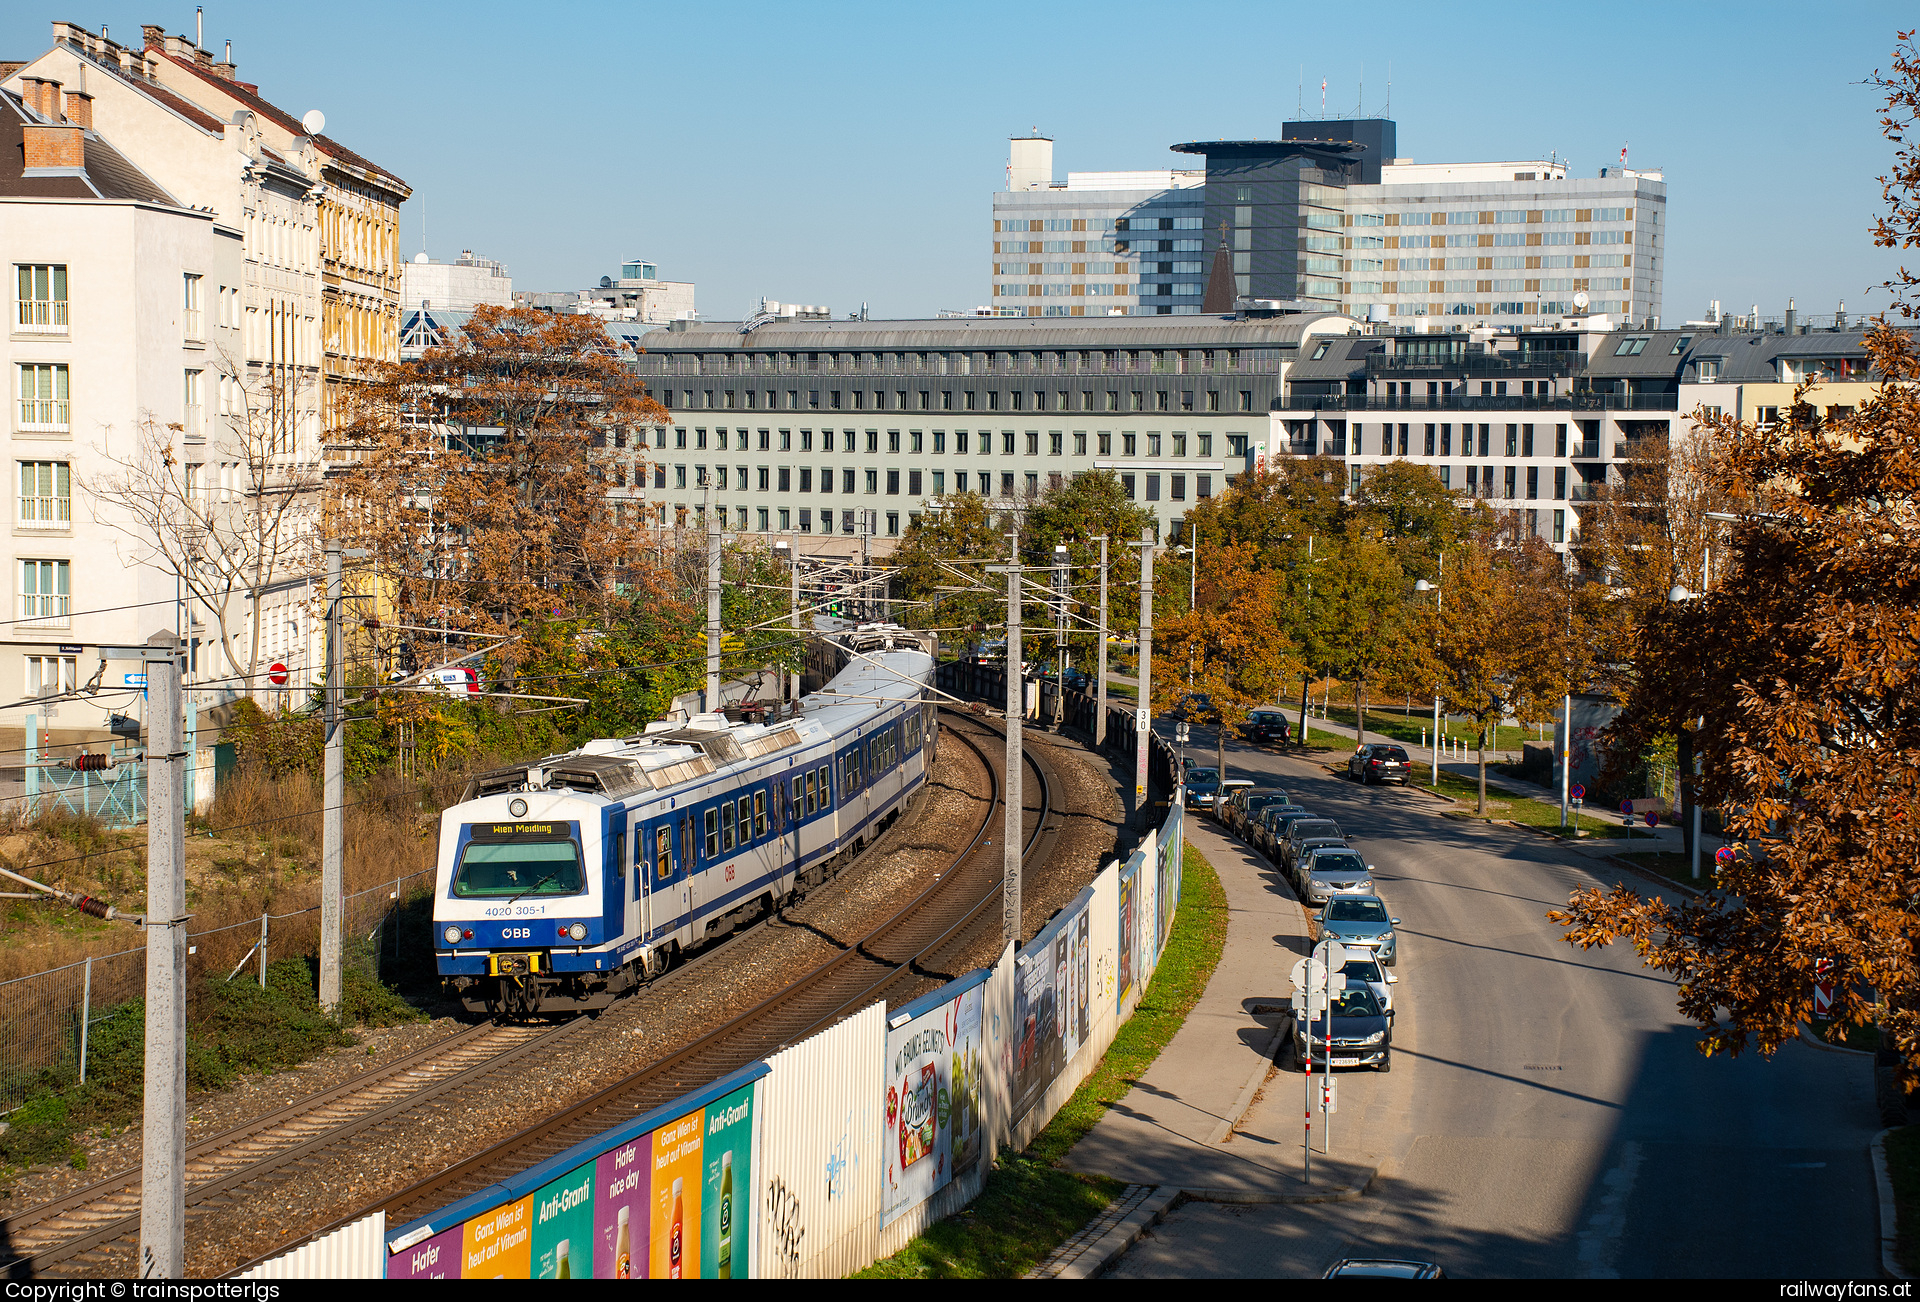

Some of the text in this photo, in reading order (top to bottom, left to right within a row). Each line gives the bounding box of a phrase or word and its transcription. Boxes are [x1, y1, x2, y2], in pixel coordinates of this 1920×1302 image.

[493, 824, 552, 834] Wien Meidling
[485, 905, 546, 917] 4020 305-1
[501, 927, 531, 939] ÖBB
[708, 1097, 749, 1136] Anti-Granti
[904, 1089, 932, 1126] Brunch
[661, 1129, 676, 1147] Ganz
[676, 1121, 691, 1141] Wien
[615, 1144, 637, 1171] Hafer
[655, 1136, 701, 1171] heut auf Vitamin
[609, 1169, 640, 1199] nice day
[538, 1177, 590, 1225] Anti-Granti
[474, 1204, 524, 1242] Ganz Wien ist
[411, 1244, 441, 1275] Hafer
[468, 1226, 528, 1270] heut auf Vitamin
